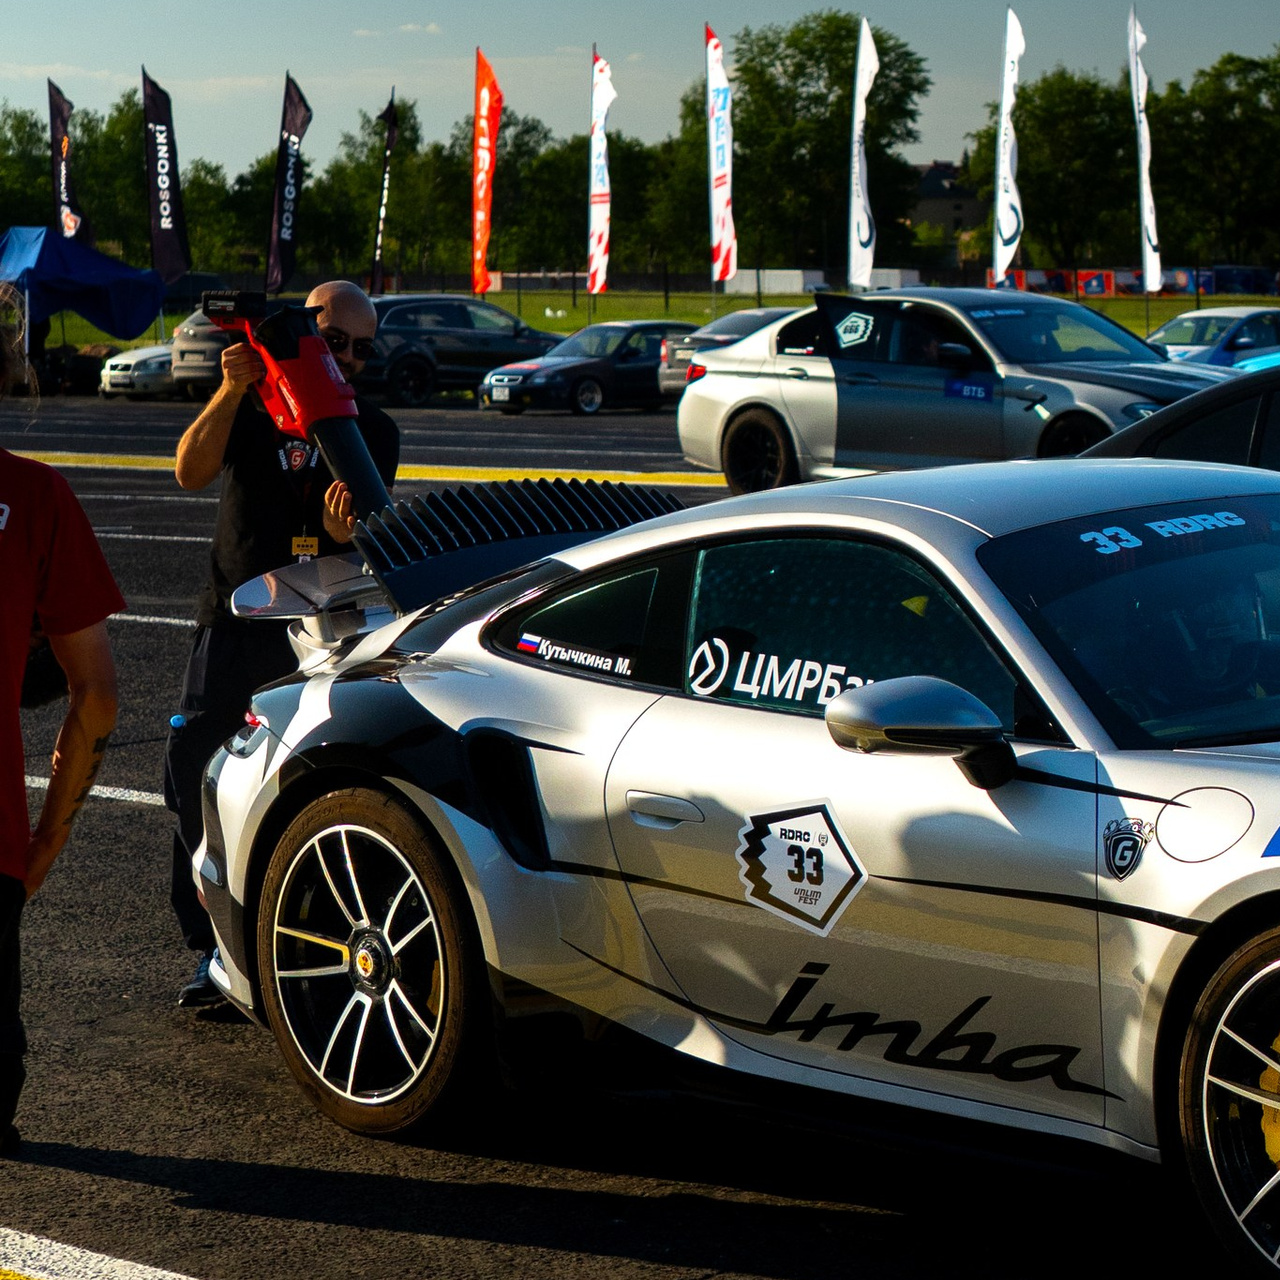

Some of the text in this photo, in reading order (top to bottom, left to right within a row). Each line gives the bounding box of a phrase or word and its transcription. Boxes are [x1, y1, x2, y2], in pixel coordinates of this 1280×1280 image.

[156, 124, 174, 231] ROSGONKI
[962, 385, 986, 399] ВТБ
[1080, 511, 1246, 555] 33 RDRC
[537, 638, 633, 676] Кутычкина М.
[733, 651, 875, 705] ЦМРБ
[779, 828, 811, 843] RDRC
[1114, 840, 1134, 867] G
[787, 844, 824, 886] 33
[793, 887, 822, 899] UNLIM
[798, 897, 819, 906] FEST
[764, 962, 1124, 1103] imba
